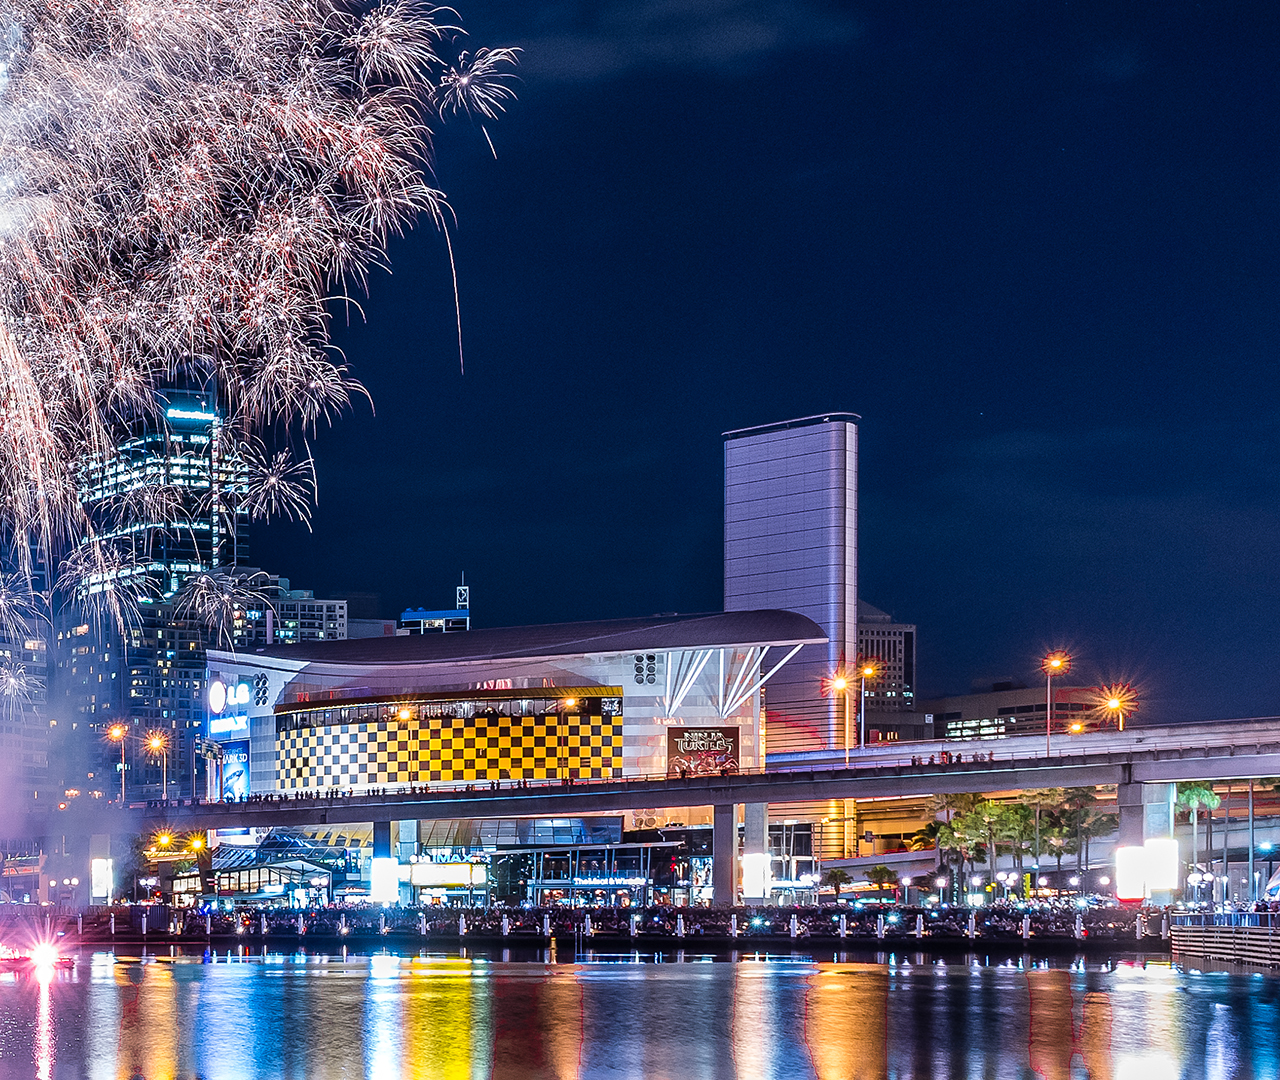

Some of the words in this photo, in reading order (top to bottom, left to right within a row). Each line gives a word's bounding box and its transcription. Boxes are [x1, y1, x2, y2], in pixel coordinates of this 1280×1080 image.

[227, 683, 250, 705] LG
[683, 732, 724, 742] NINJA
[674, 738, 733, 754] TURTLES
